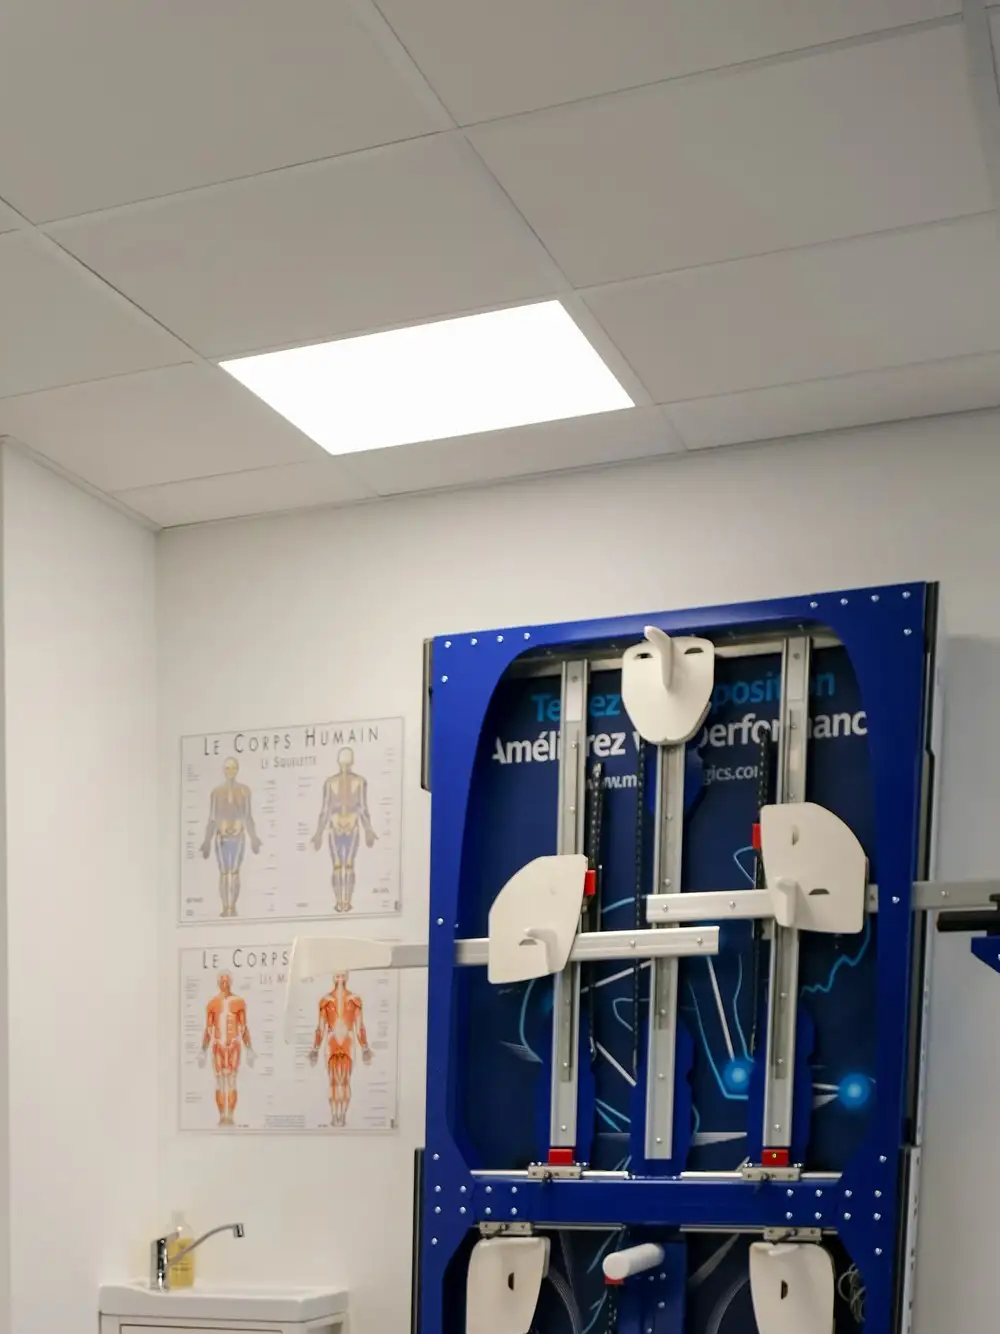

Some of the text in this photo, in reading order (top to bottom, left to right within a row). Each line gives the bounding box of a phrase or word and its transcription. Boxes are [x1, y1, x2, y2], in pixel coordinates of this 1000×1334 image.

[531, 692, 622, 722] Teez
[203, 726, 379, 756] LE CORPS HUMAIN
[492, 730, 627, 764] Amélirez
[698, 710, 869, 748] erforanc
[203, 948, 290, 969] LE CORPS
